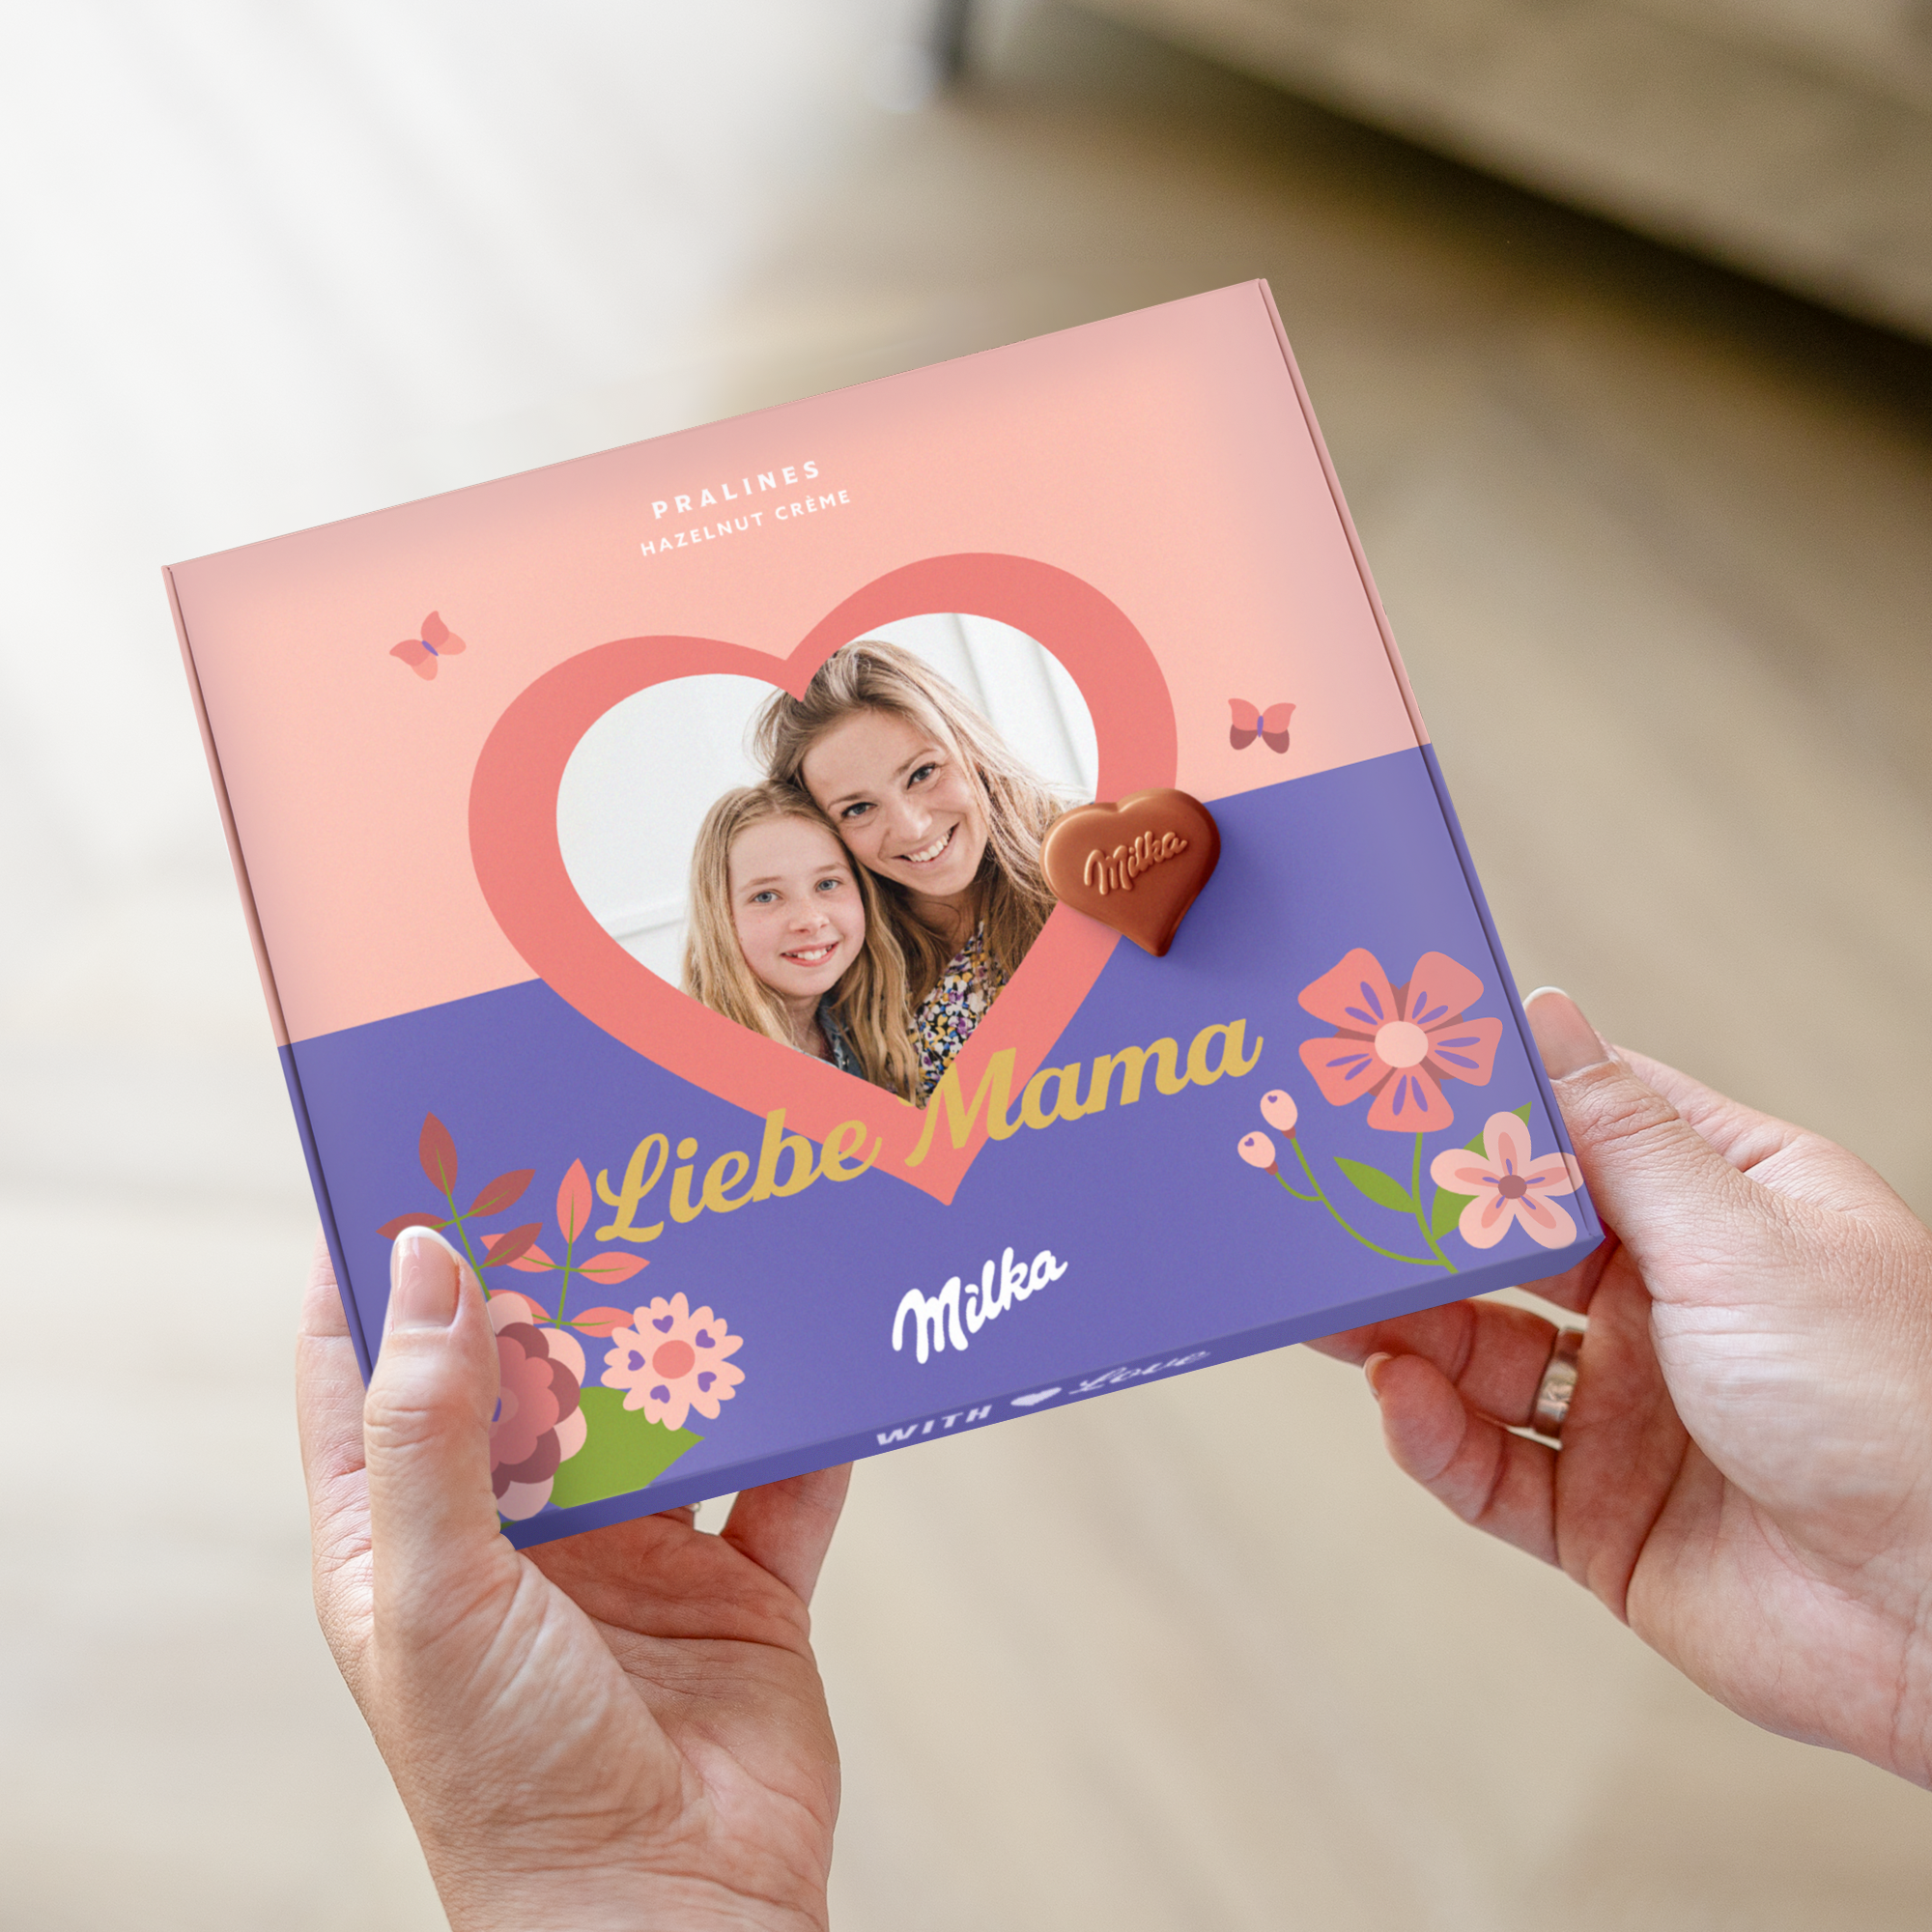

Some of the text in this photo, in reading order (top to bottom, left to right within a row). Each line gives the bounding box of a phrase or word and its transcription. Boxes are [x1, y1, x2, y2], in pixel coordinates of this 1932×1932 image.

[640, 490, 851, 556] HAZELNUT CRÈME
[651, 461, 819, 520] PRALINES
[1083, 831, 1188, 895] Milka
[594, 1018, 1264, 1243] Liebe Mama
[892, 1246, 1068, 1364] Milka
[876, 1405, 992, 1445] WITH
